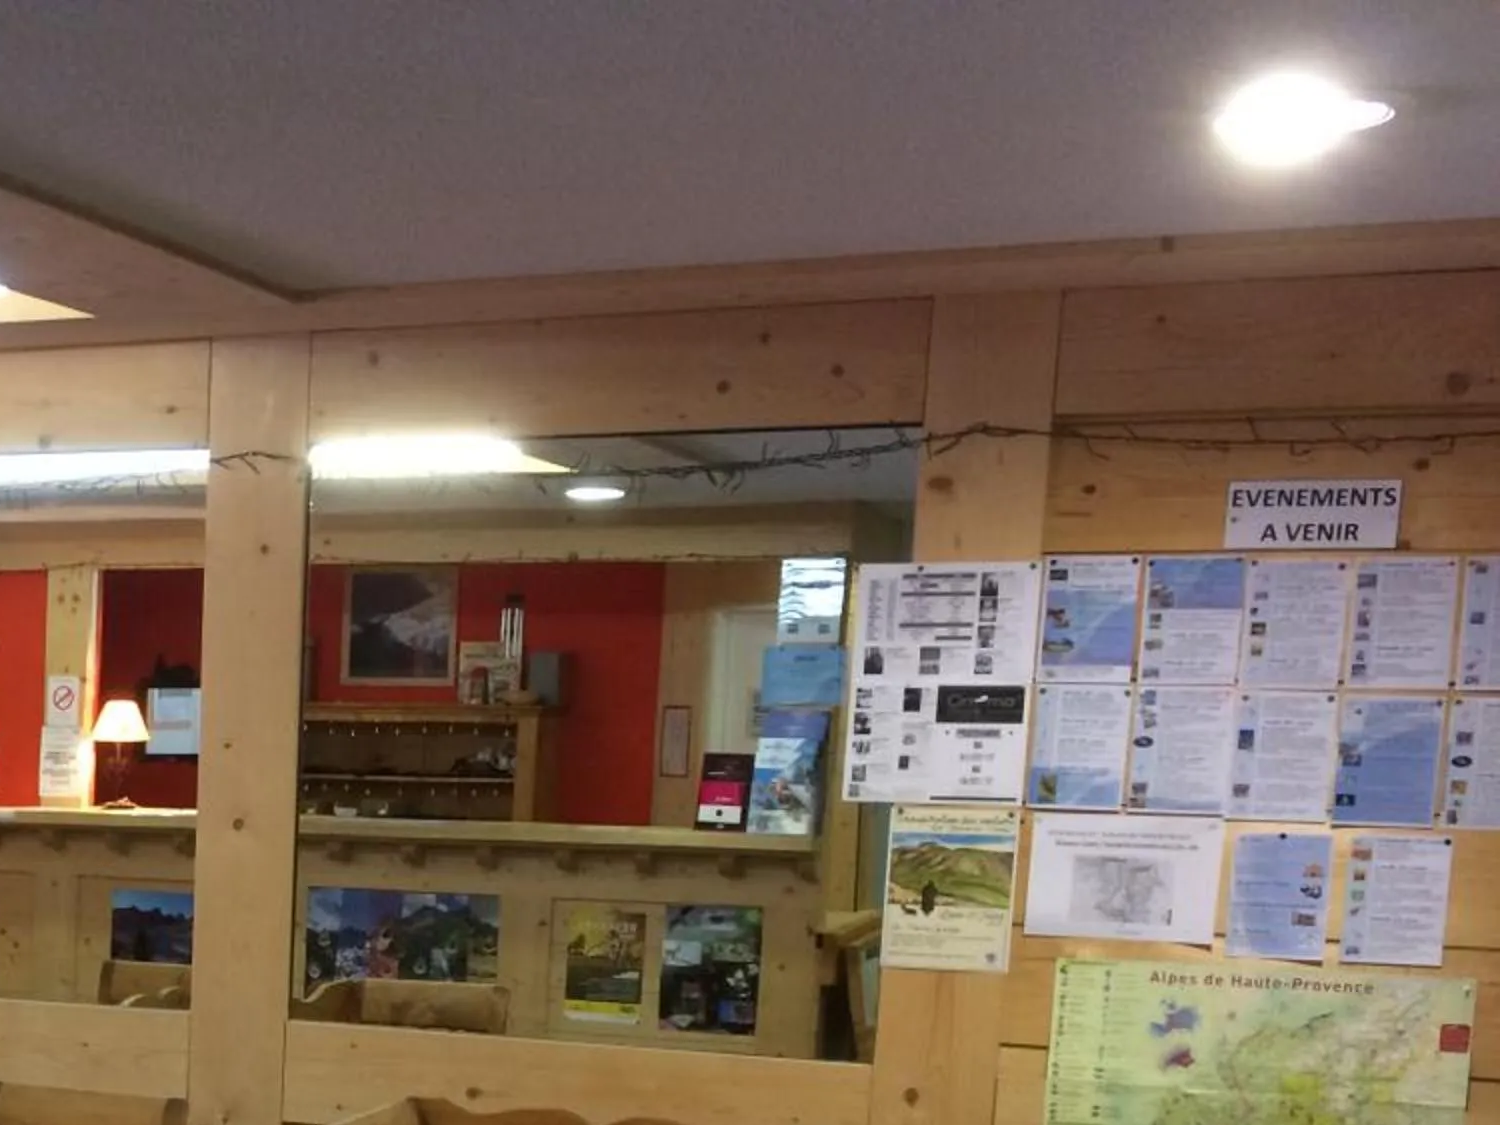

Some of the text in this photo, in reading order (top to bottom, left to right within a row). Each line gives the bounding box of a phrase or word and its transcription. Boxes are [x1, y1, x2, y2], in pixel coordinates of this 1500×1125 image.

[1231, 488, 1397, 508] EVENEMENTS
[1260, 523, 1359, 541] A VENIR
[1150, 970, 1375, 995] Alpes de Haute-Provence
